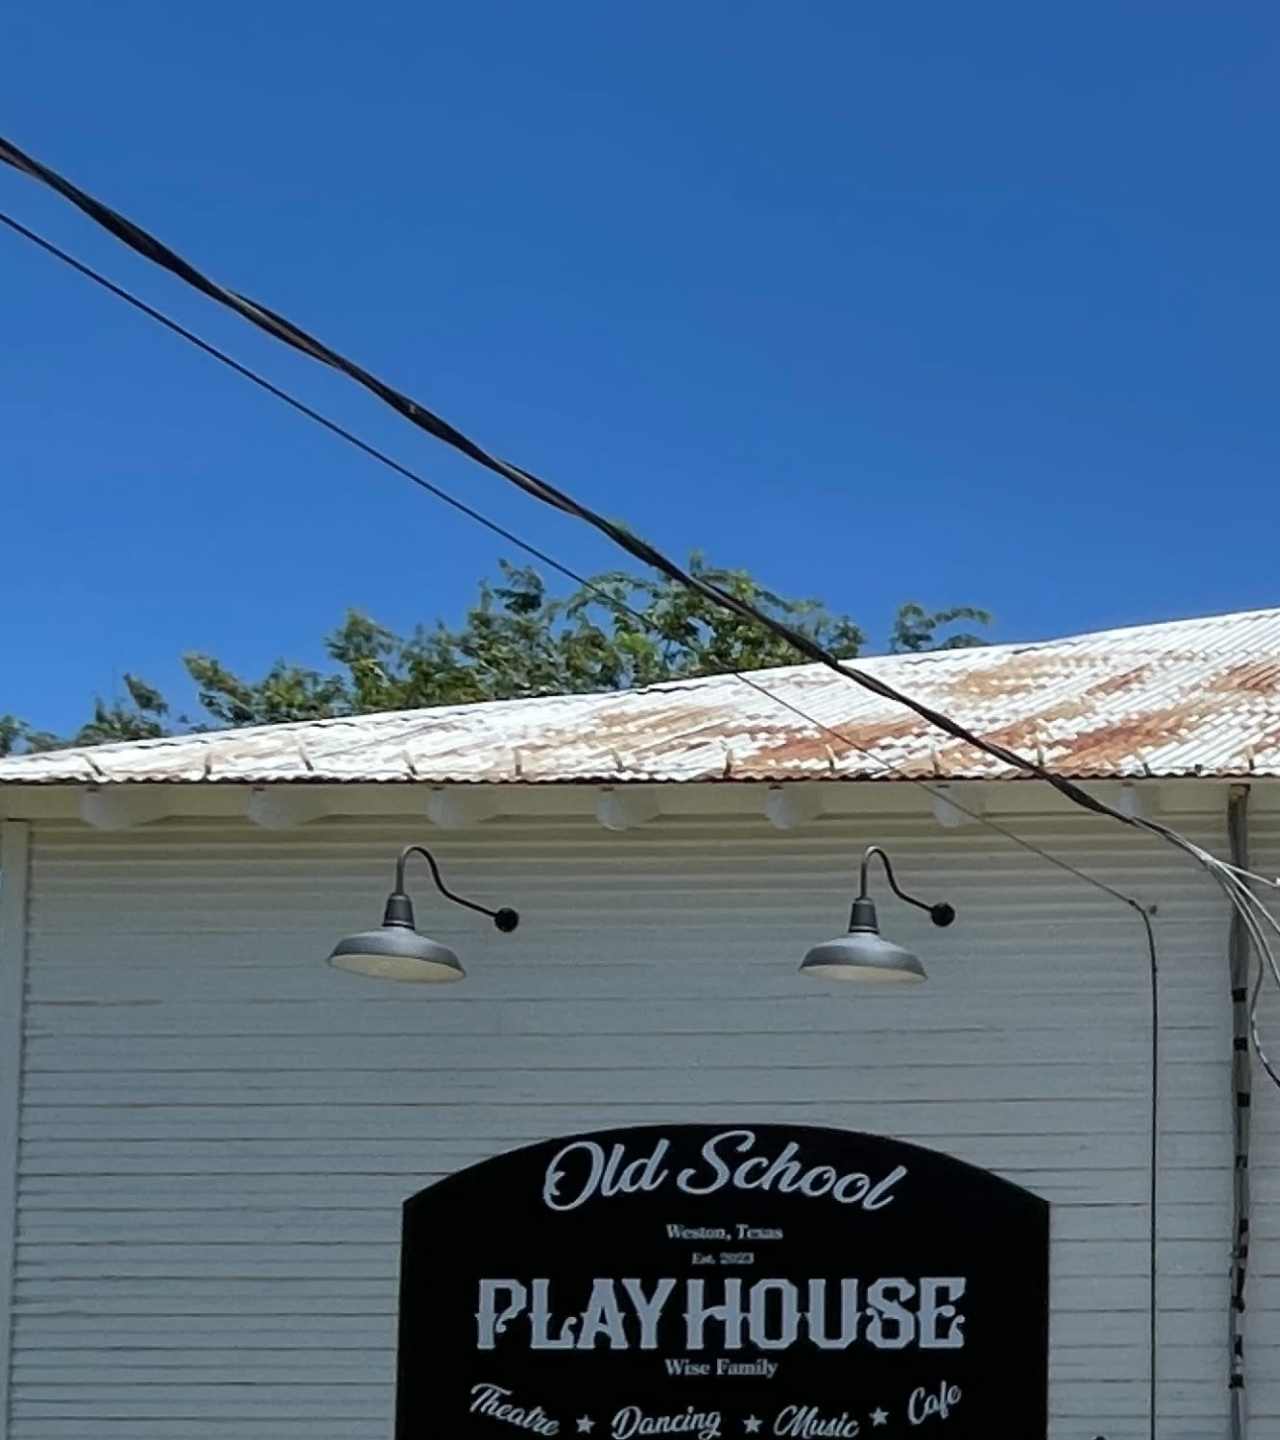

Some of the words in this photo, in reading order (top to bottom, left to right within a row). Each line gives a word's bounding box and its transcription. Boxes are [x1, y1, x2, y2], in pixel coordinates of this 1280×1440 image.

[543, 1138, 670, 1211] Old
[676, 1130, 907, 1210] School
[665, 1223, 732, 1241] Weston,
[735, 1223, 784, 1240] Texas
[475, 1277, 967, 1350] PLAYHOUSE
[664, 1358, 710, 1376] Wise
[716, 1358, 779, 1379] Family
[469, 1383, 560, 1436] Theatre
[611, 1405, 722, 1440] Dancing
[773, 1404, 860, 1439] Music
[907, 1379, 962, 1425] Cafe
